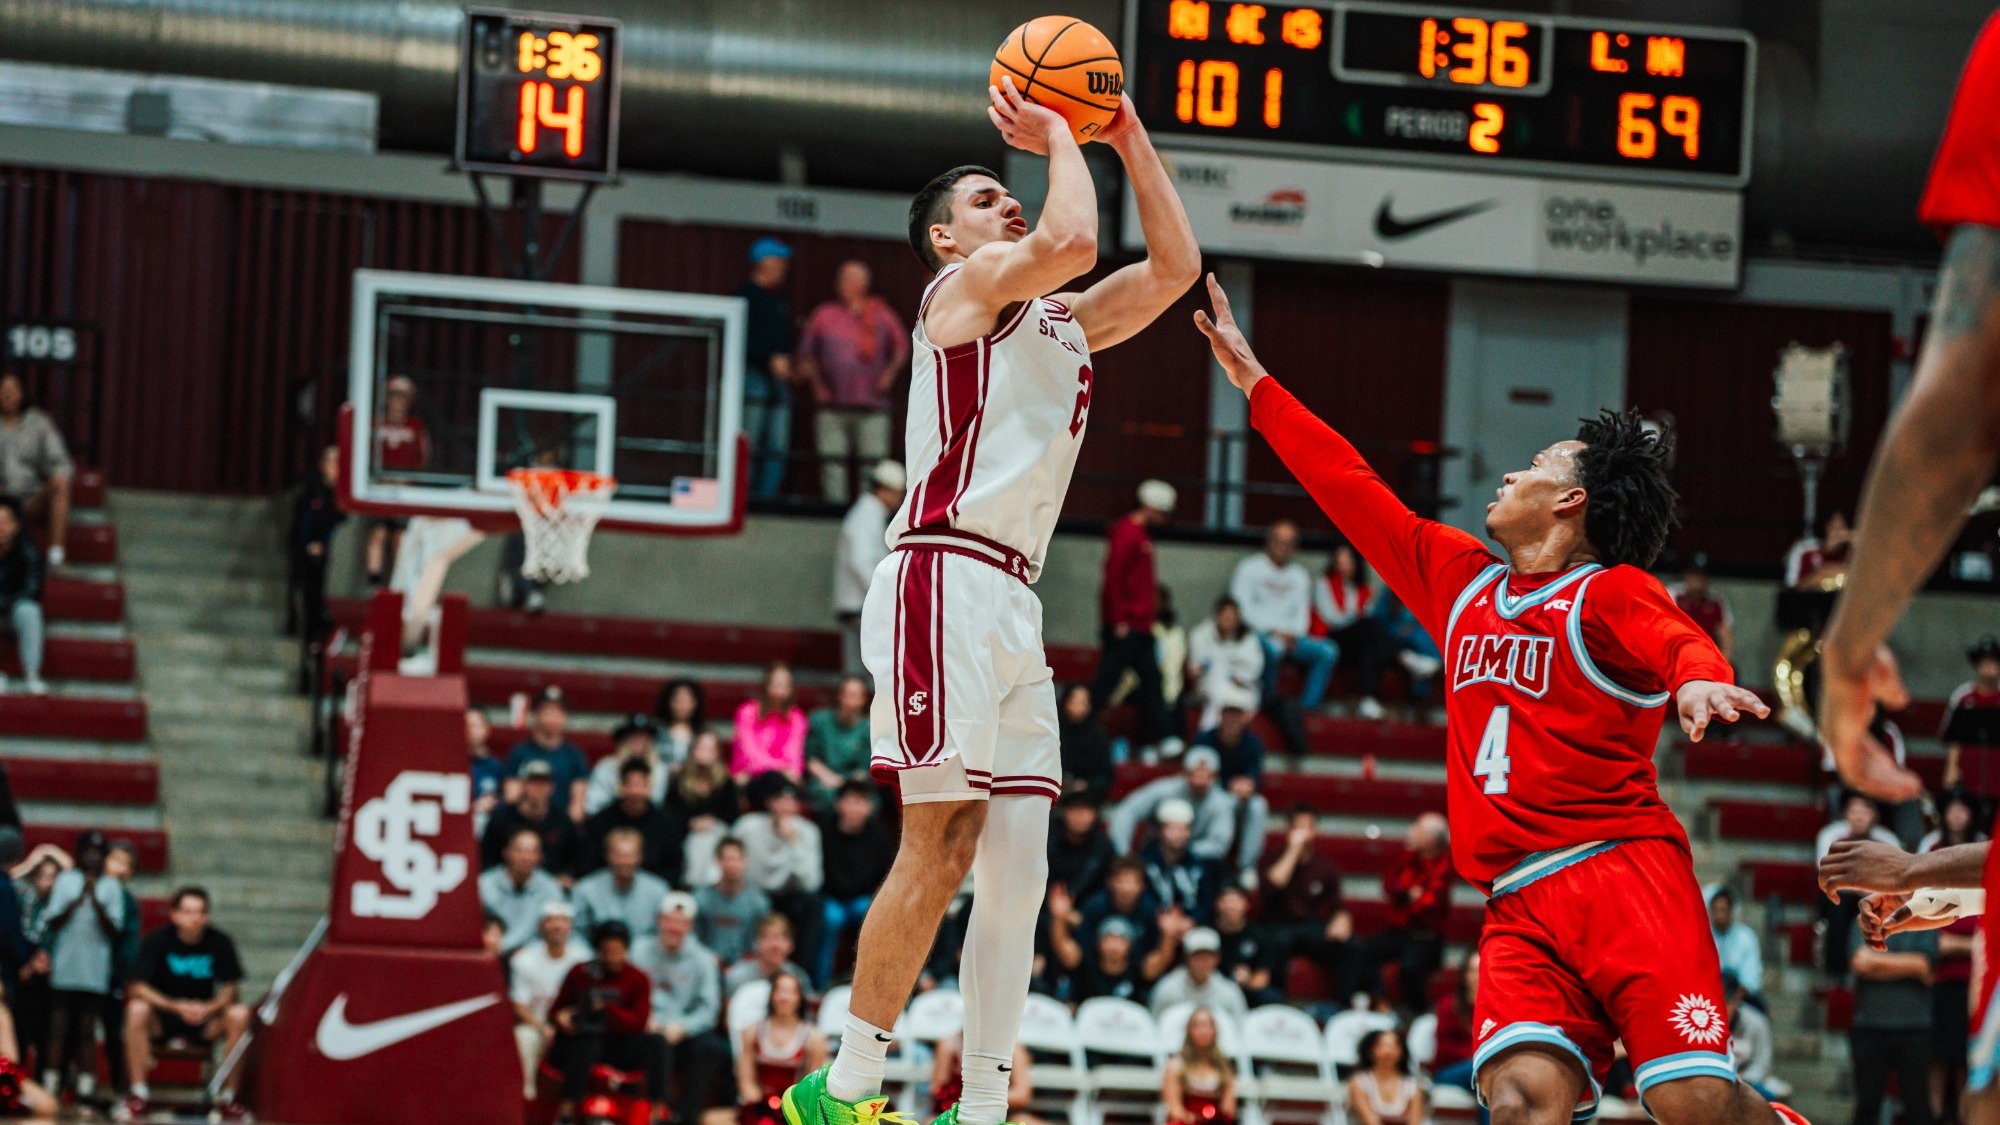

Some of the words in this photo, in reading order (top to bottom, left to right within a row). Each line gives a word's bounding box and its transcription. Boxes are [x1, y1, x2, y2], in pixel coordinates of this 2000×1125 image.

[518, 31, 602, 82] 1:36
[1418, 17, 1531, 88] 1:36
[518, 80, 585, 158] 14
[1176, 59, 1284, 129] 101
[1616, 92, 1700, 160] 69
[1469, 103, 1504, 153] 2
[1545, 197, 1615, 227] one
[1546, 218, 1733, 268] workplace
[8, 325, 76, 360] 105
[1069, 363, 1093, 440] 2
[1453, 634, 1555, 699] LMU
[1473, 705, 1511, 795] 4
